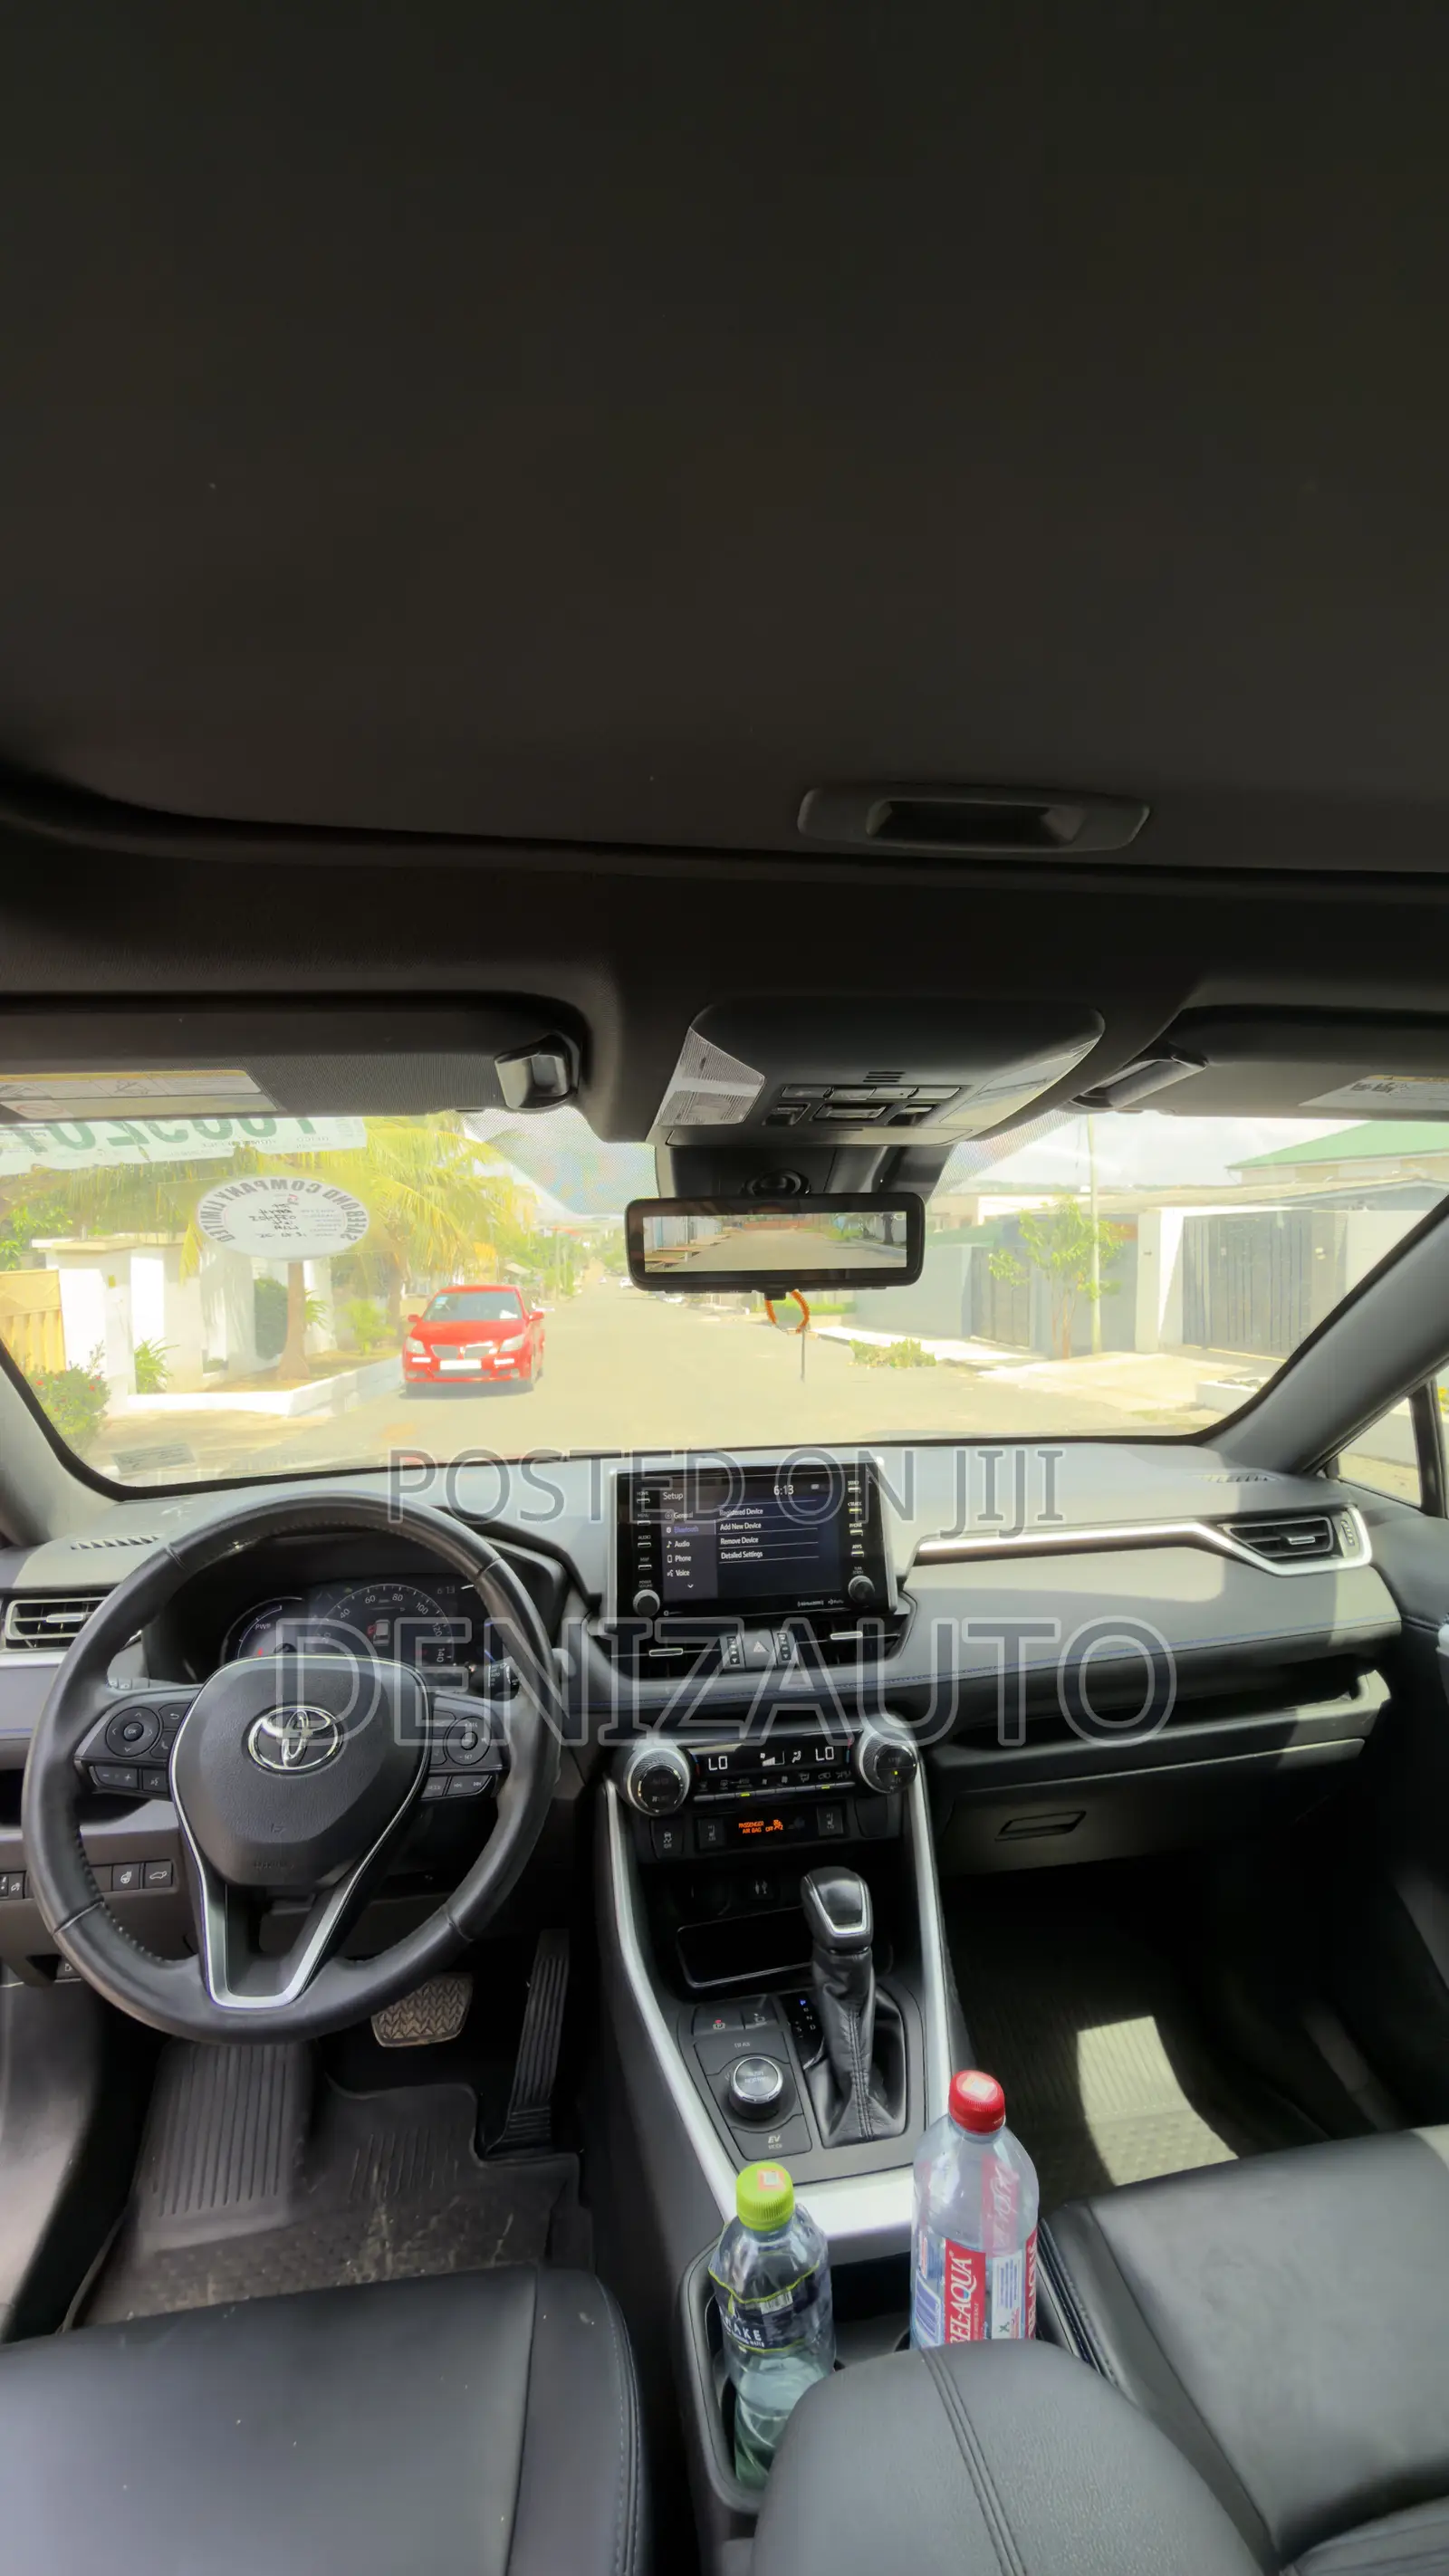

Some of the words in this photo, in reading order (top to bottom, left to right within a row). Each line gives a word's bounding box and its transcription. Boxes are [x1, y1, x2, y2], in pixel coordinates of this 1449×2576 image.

[773, 1485, 794, 1496] 6:13
[662, 1492, 684, 1501] Setup
[719, 1508, 745, 1517] Registered
[743, 1551, 763, 1559] Settings
[365, 1594, 376, 1604] 60
[392, 1593, 403, 1602] 80
[340, 1608, 350, 1619] 40
[415, 1602, 428, 1615] 100
[432, 1622, 442, 1638] 120
[815, 1747, 835, 1761] LO
[708, 1756, 728, 1771] LO
[768, 2134, 782, 2143] EV
